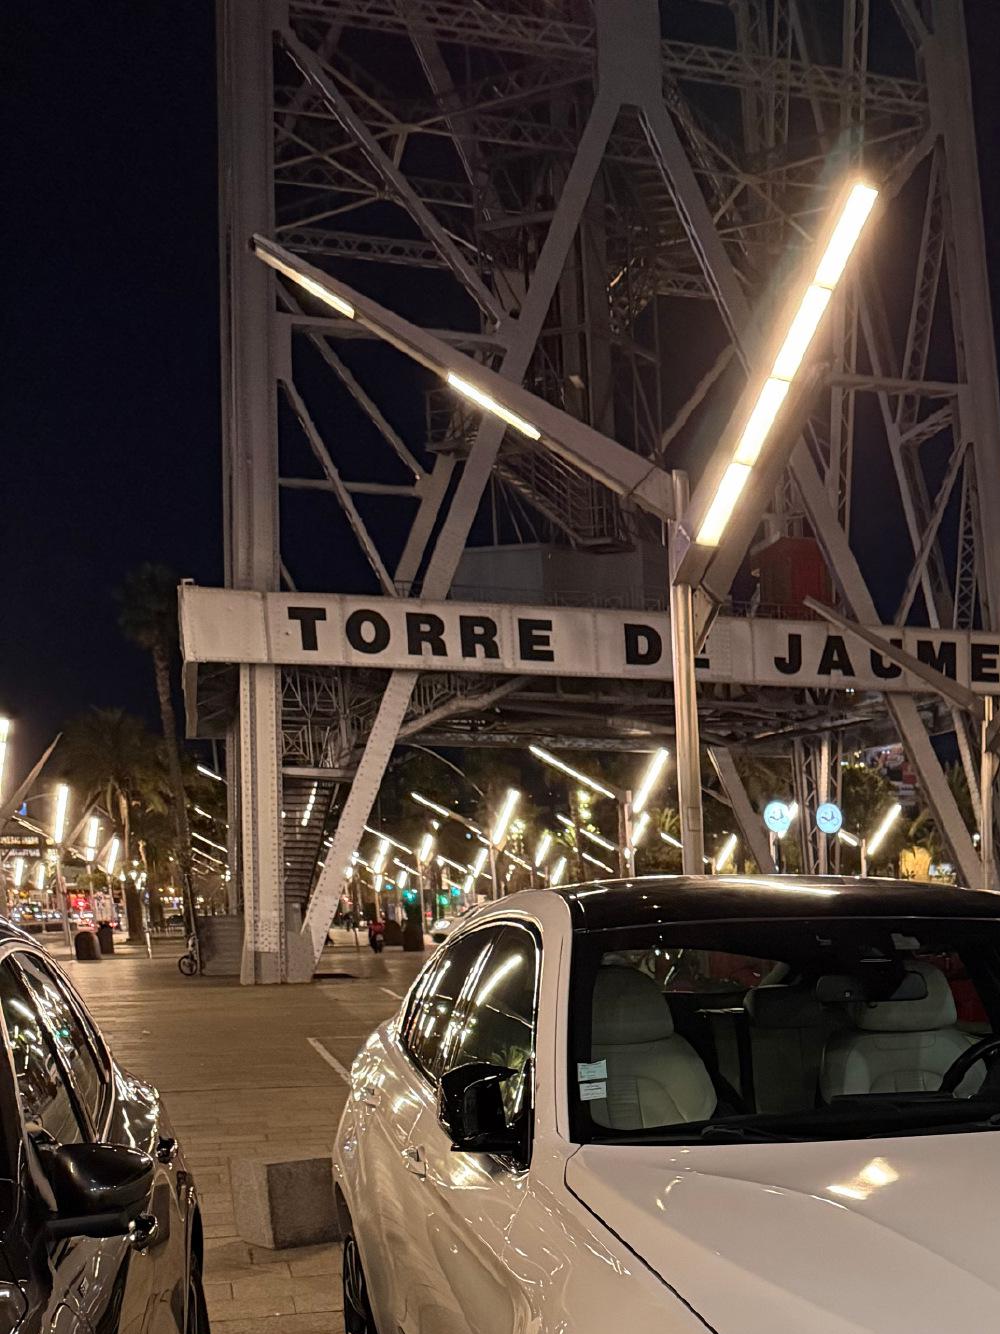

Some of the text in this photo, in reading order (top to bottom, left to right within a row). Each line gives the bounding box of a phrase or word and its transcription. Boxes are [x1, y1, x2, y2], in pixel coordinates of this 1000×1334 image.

[287, 606, 1000, 683] TORRE D JAUME
